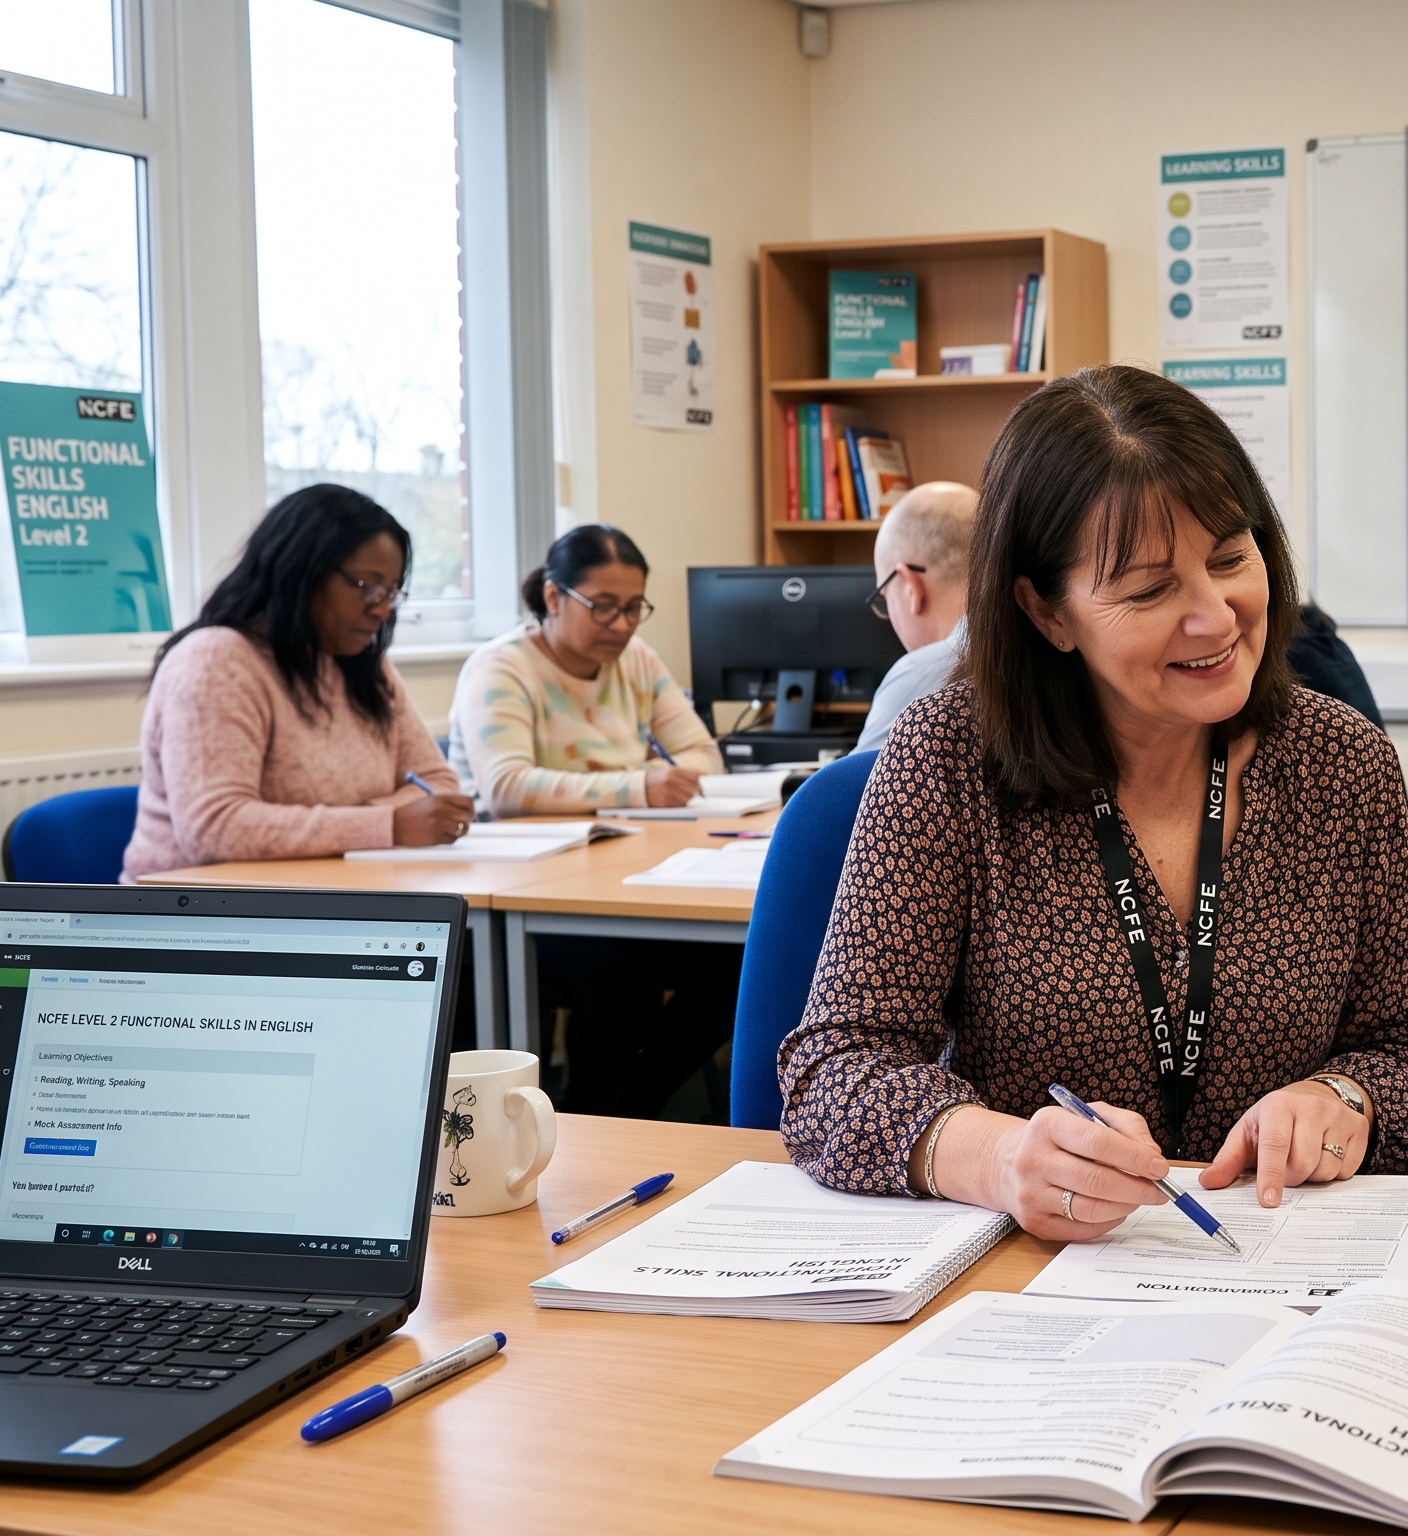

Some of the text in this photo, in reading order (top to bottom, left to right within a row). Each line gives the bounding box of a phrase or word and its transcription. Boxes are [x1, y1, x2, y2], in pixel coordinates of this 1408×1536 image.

[1165, 156, 1280, 176] LEARNING SKILLS
[835, 294, 907, 307] FUNCTIONAL
[1234, 364, 1281, 380] SKILLS
[78, 398, 134, 420] NCFE
[8, 436, 145, 466] FUNCTIONAL
[12, 466, 85, 491] SKILLS
[16, 494, 109, 520] ENGLISH
[20, 524, 88, 546] Level 2
[1208, 757, 1225, 820] NCFE
[1115, 878, 1146, 944] NCFE
[1197, 883, 1216, 947] NCFE
[38, 1013, 313, 1033] NCFE LEVEL 2 FUNCTIONAL SKILLS IN ENGLISH
[1151, 1006, 1174, 1074] NCFE
[1181, 1010, 1205, 1076] NCFE
[73, 1053, 113, 1064] Objectives
[109, 1078, 146, 1089] Speaking
[34, 1120, 55, 1129] Mock
[106, 1122, 122, 1131] Info
[118, 1257, 152, 1270] DELL
[633, 1266, 708, 1277] SKILLS
[789, 1257, 879, 1268] ENGLISH
